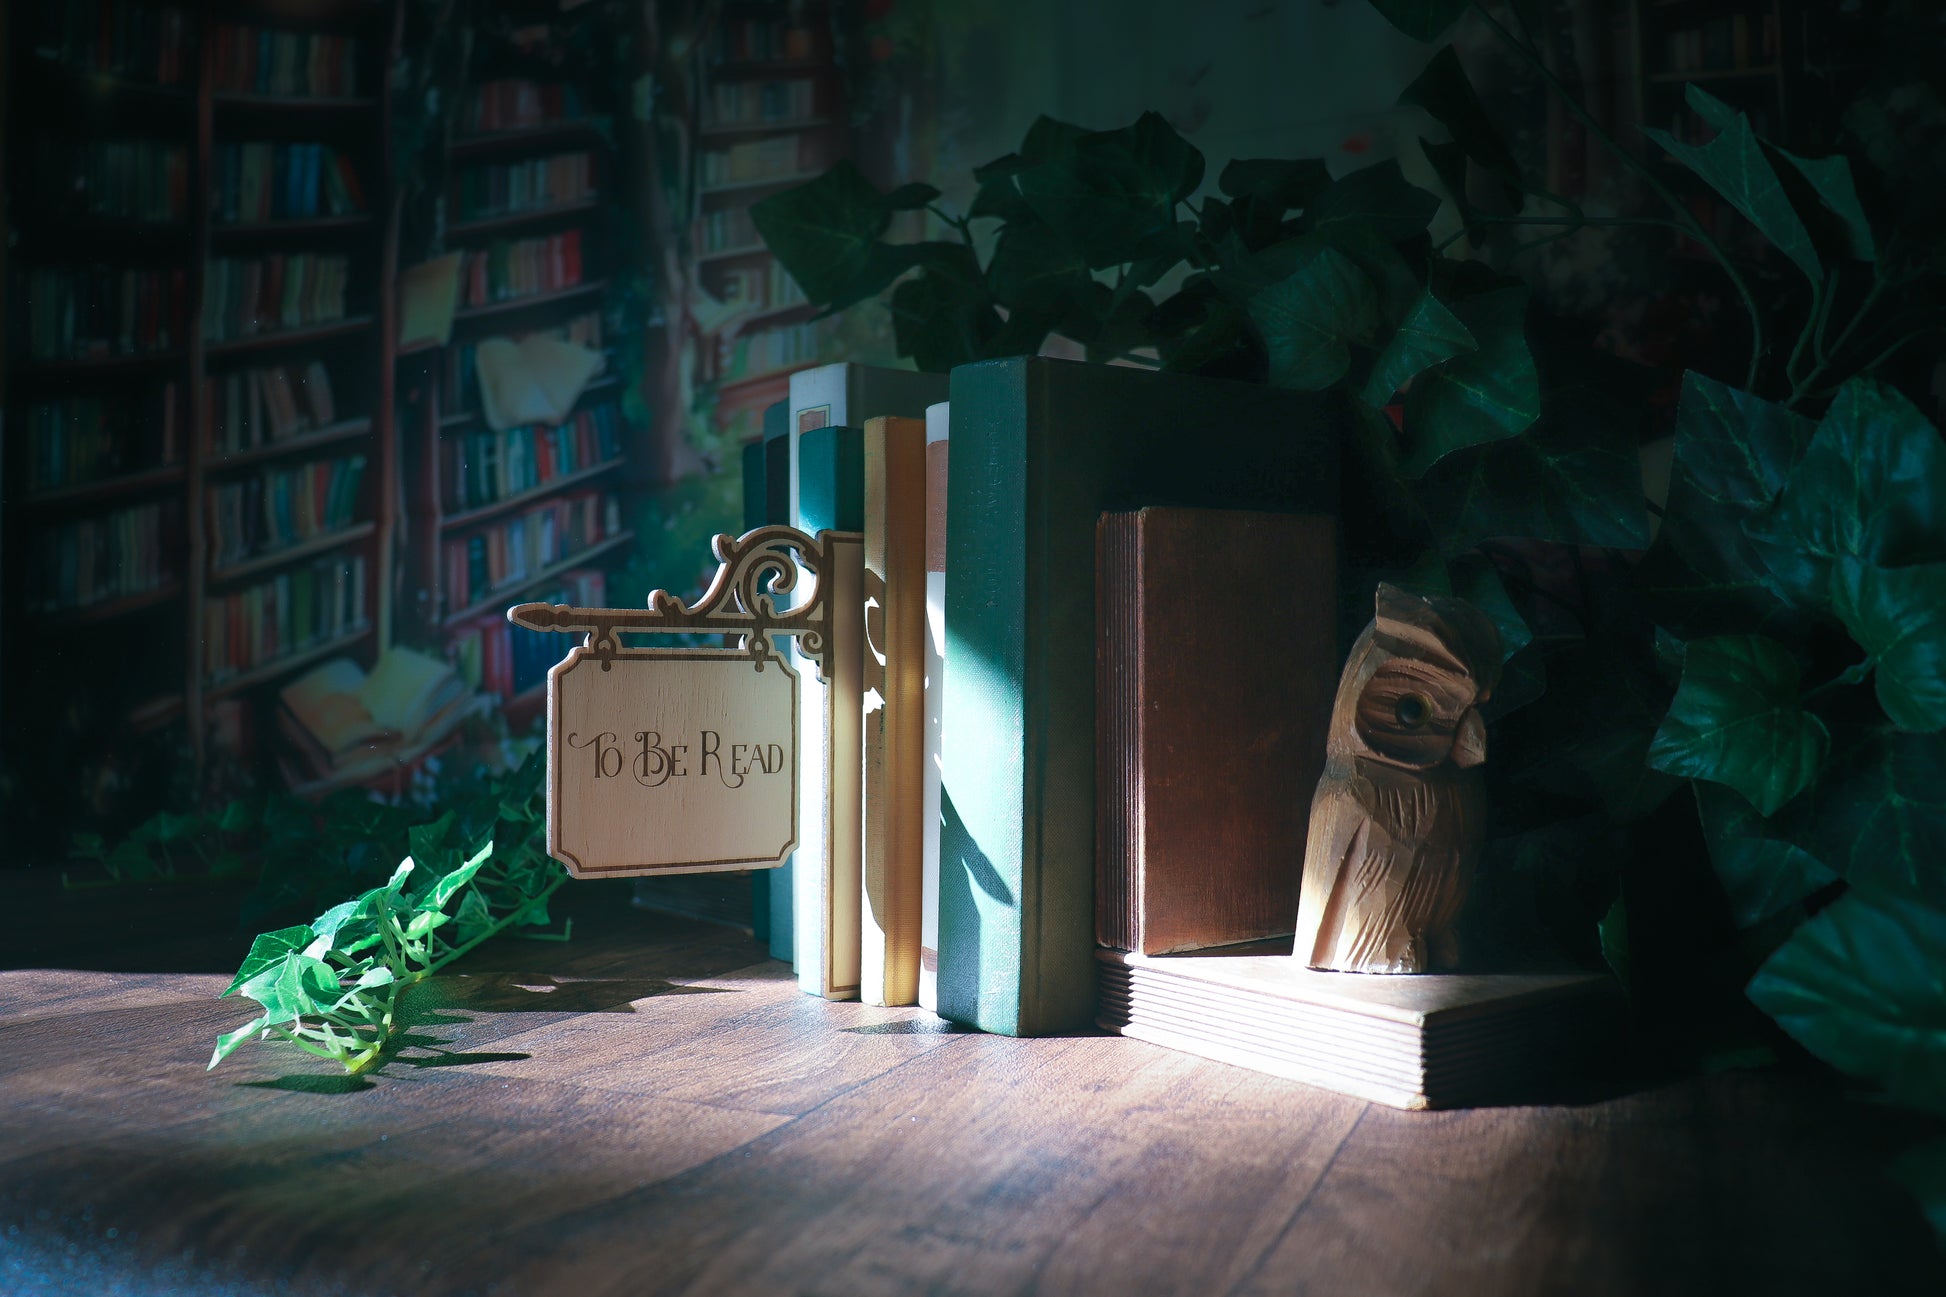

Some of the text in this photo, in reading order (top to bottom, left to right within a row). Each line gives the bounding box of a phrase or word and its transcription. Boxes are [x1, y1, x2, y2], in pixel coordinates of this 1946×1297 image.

[567, 730, 784, 788] TO BE READ
